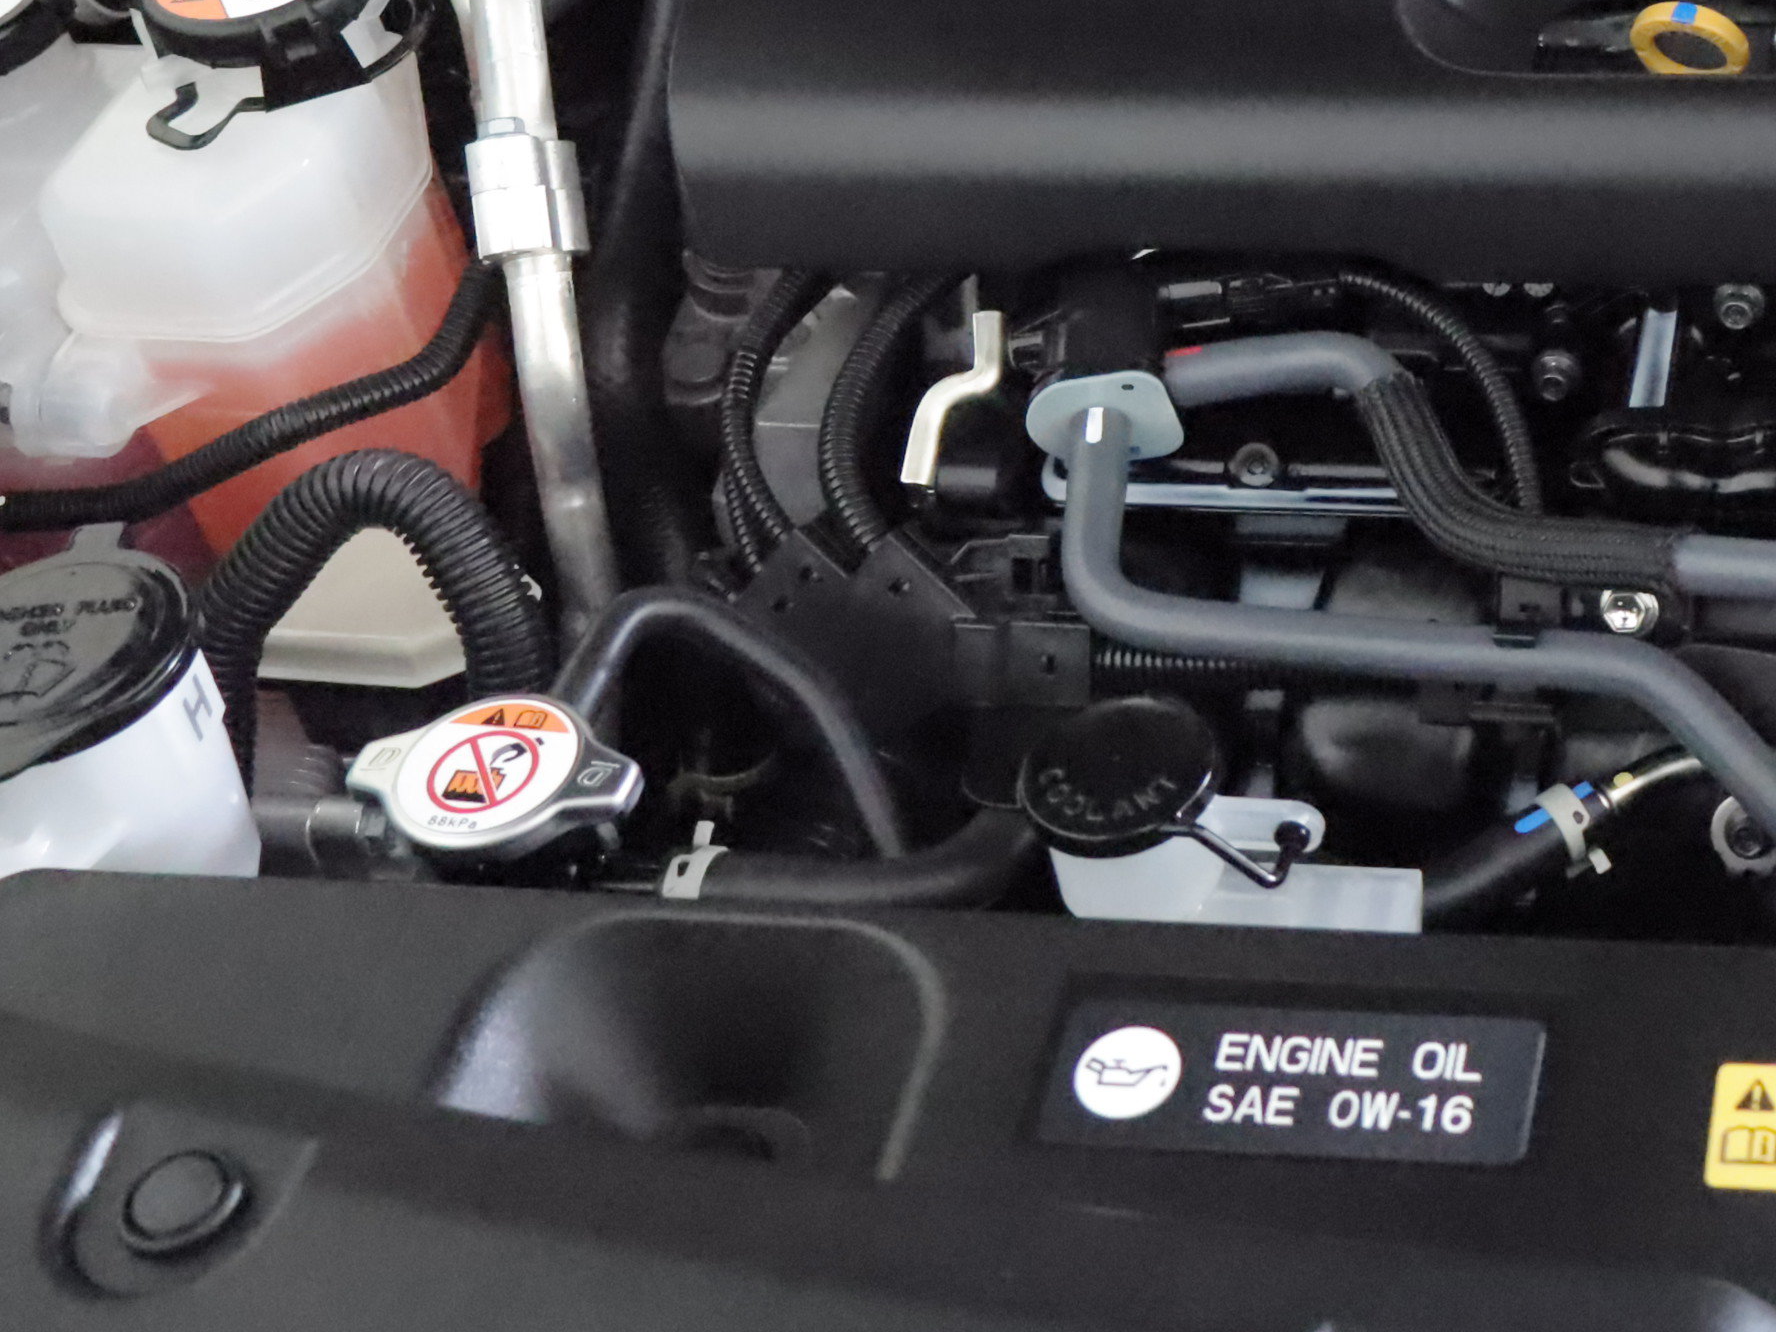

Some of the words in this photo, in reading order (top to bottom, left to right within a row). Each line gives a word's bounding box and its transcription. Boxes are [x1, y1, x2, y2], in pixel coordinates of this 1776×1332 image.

[182, 673, 213, 742] H
[1038, 768, 1178, 821] COOLANT
[1214, 1032, 1385, 1078] ENGINE
[1411, 1041, 1483, 1083] OIL
[1202, 1084, 1301, 1127] SAE
[1327, 1089, 1475, 1134] 0W-16
